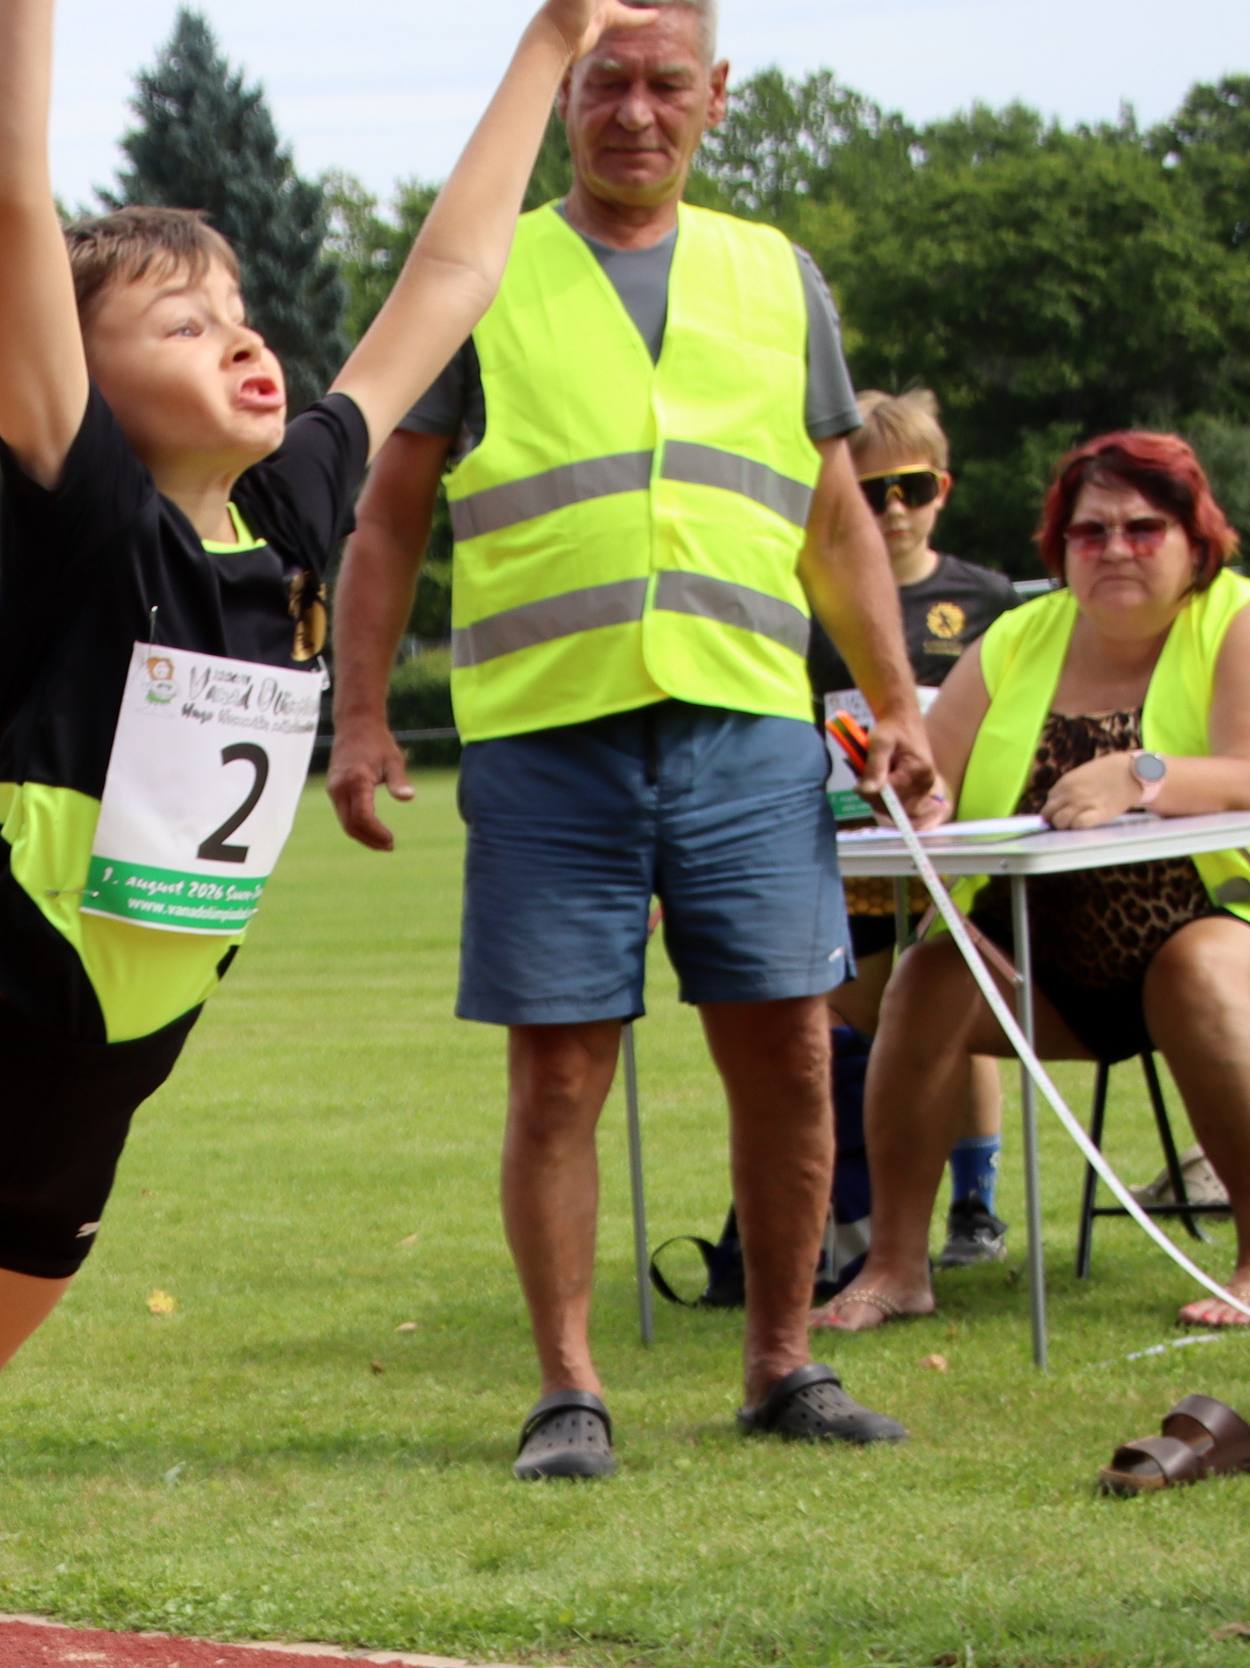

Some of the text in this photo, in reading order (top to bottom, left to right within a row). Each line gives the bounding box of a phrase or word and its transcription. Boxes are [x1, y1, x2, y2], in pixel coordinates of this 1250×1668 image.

[196, 741, 270, 864] 2
[125, 876, 185, 897] august
[187, 880, 225, 901] 2026
